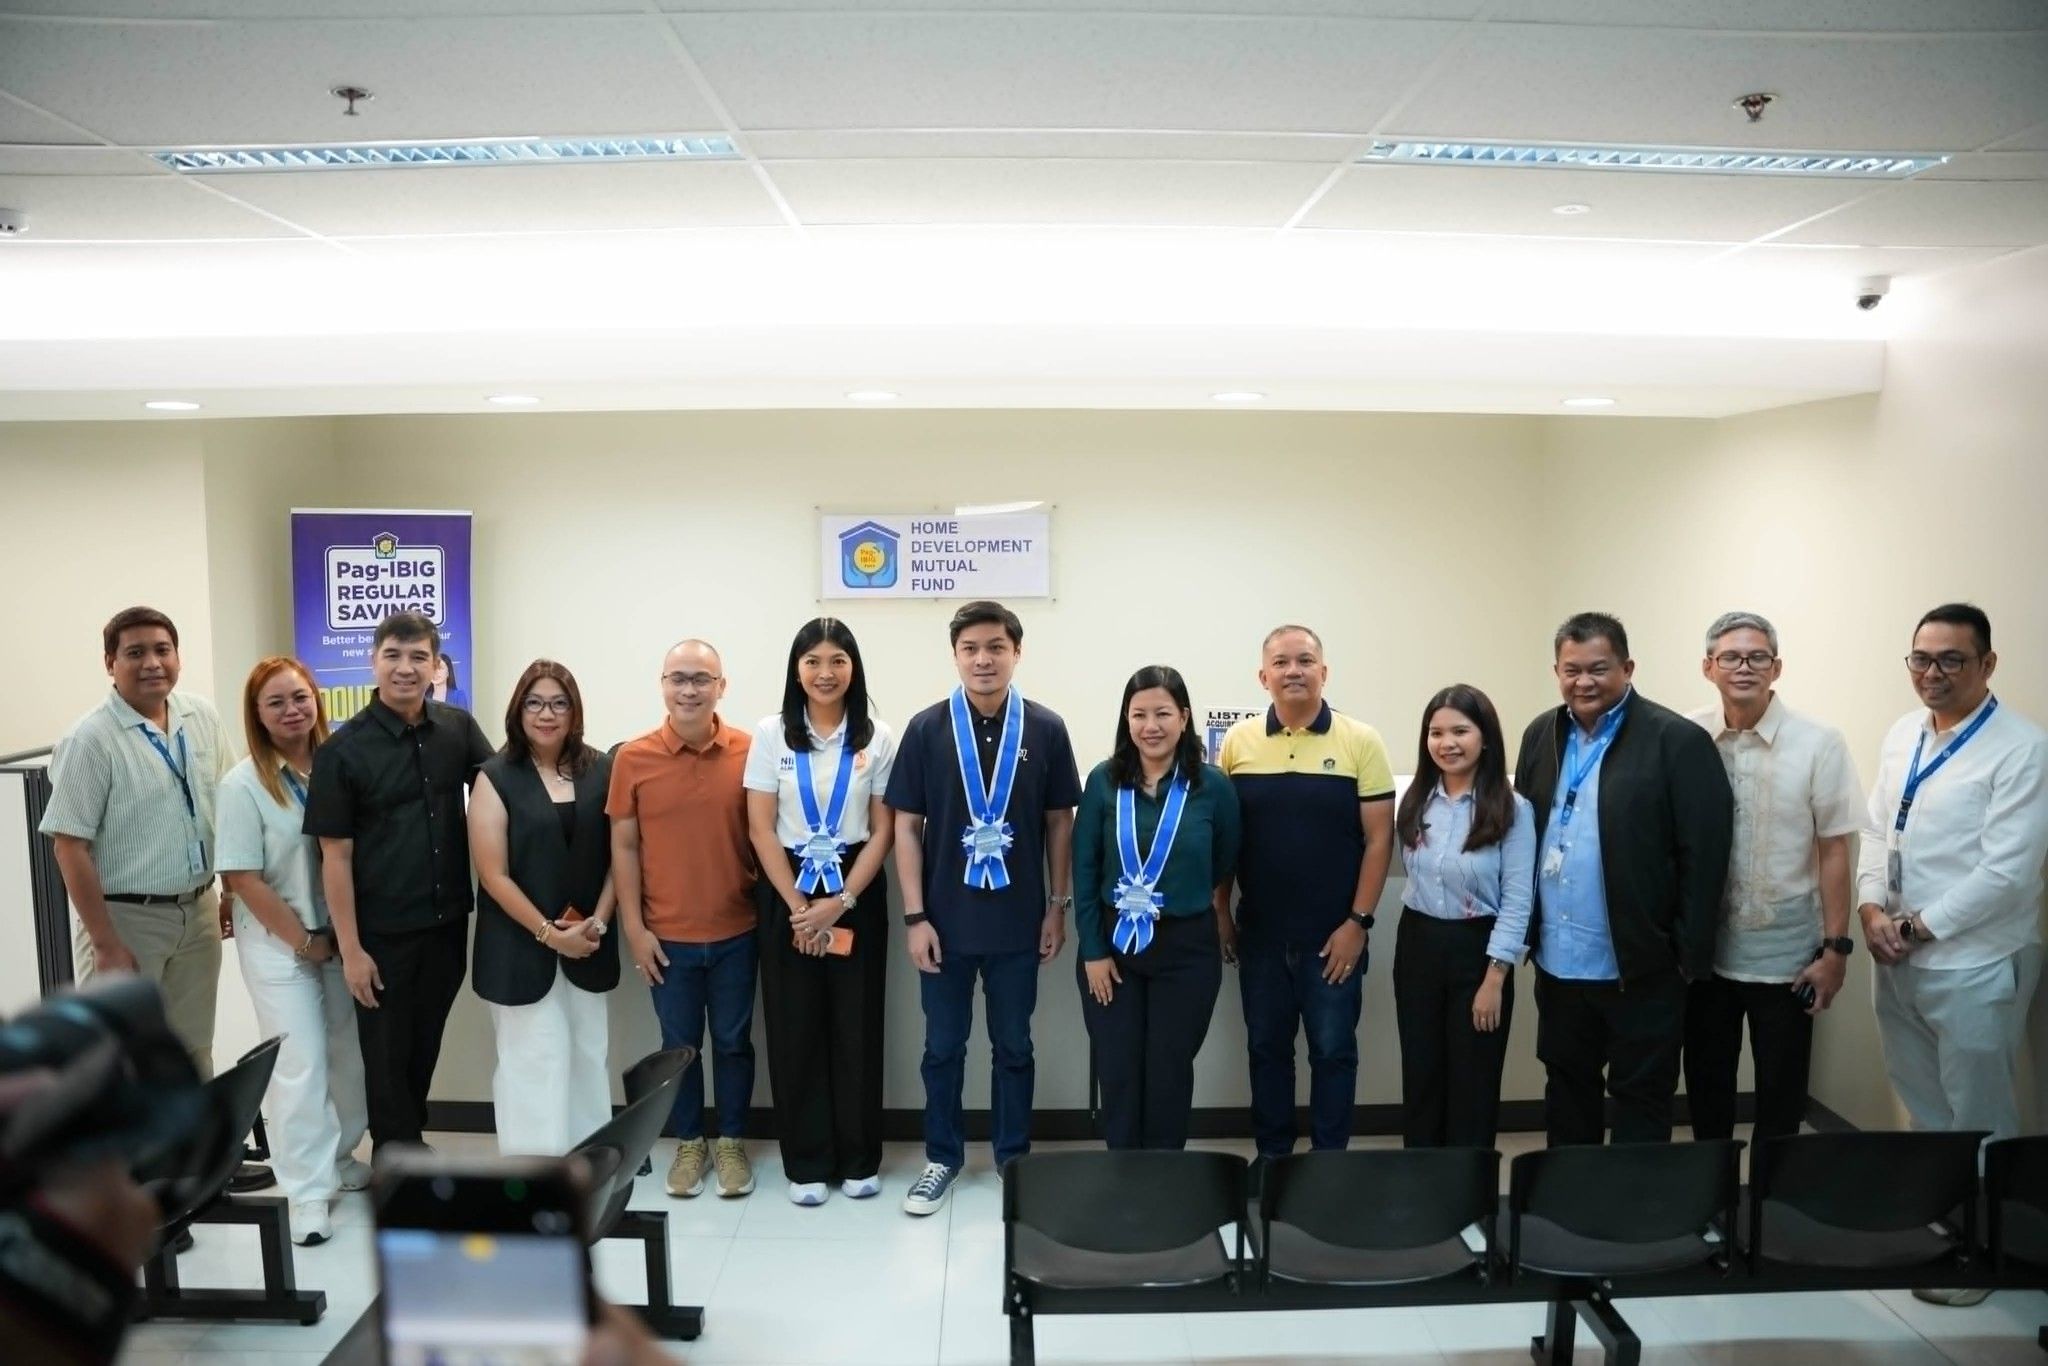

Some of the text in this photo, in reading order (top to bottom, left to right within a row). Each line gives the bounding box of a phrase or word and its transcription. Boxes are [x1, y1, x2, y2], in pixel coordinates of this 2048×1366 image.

[911, 521, 958, 534] HOME
[911, 540, 1033, 553] DEVELOPMENT
[336, 560, 436, 581] Pag-IBIG
[911, 560, 978, 572] MUTUAL
[911, 578, 955, 591] FUND
[337, 584, 436, 601] REGULAR
[322, 635, 356, 646] Better
[342, 648, 365, 657] new
[1209, 711, 1240, 719] LIST
